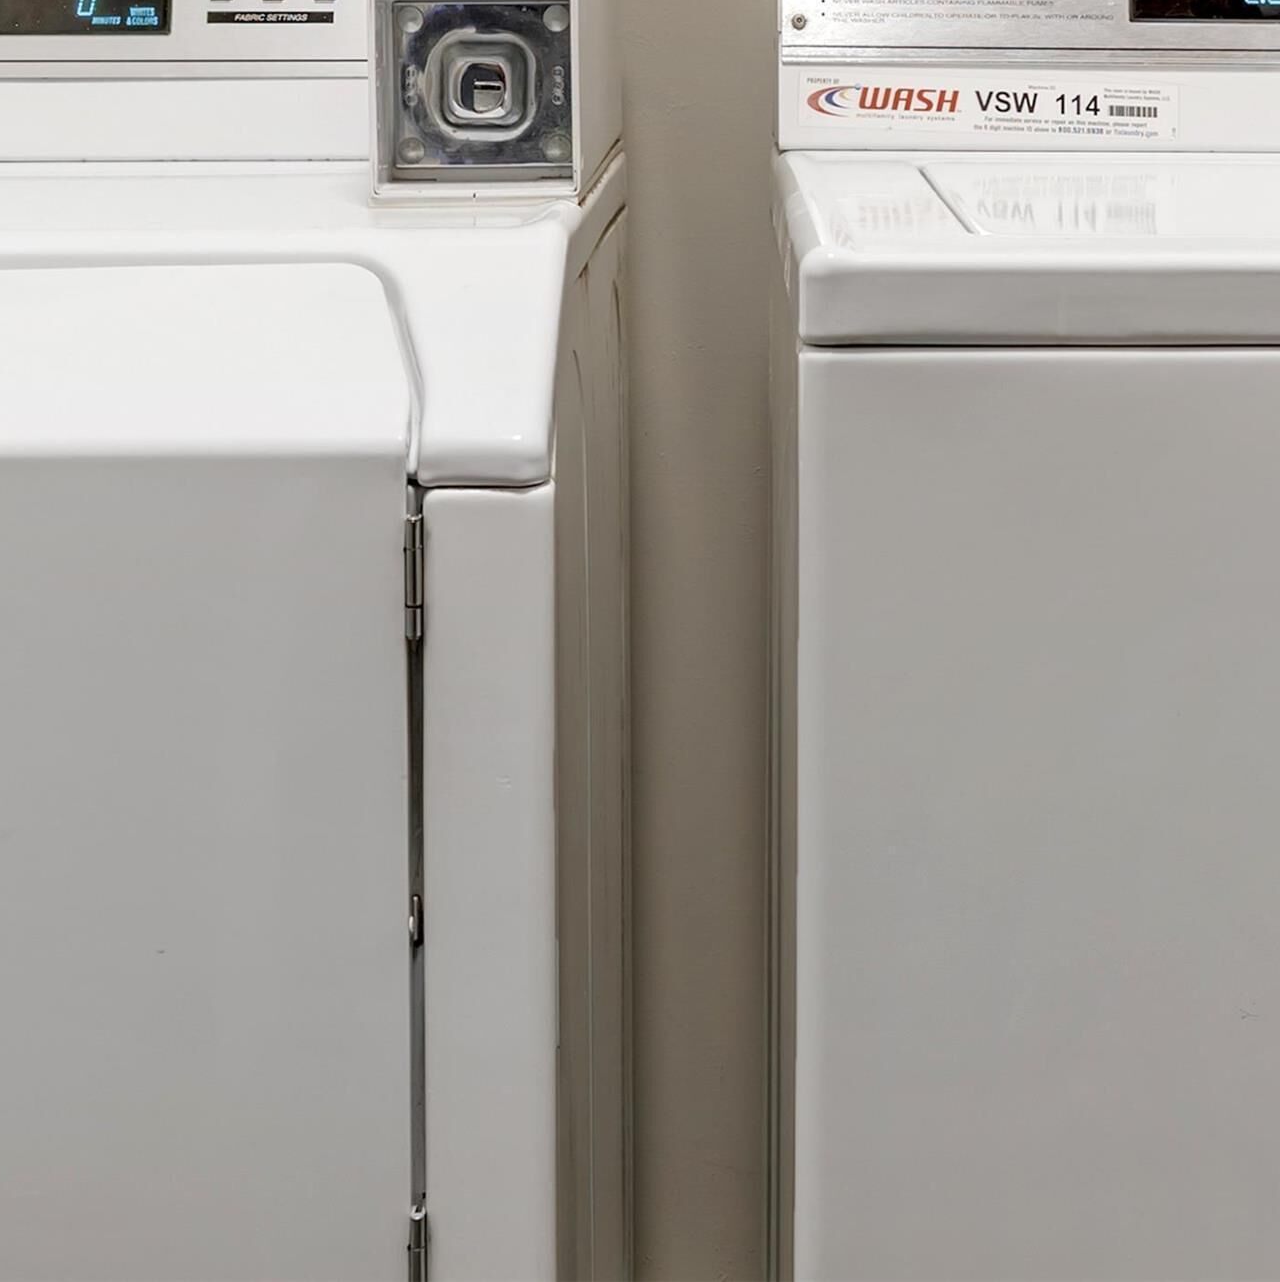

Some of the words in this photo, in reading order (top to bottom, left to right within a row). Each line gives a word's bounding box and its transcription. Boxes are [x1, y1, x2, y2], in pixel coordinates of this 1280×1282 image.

[234, 14, 264, 22] FABRIC
[266, 14, 308, 22] SETTINGS
[859, 87, 960, 113] WASH
[975, 91, 1038, 113] VSW
[1056, 94, 1100, 116] 114
